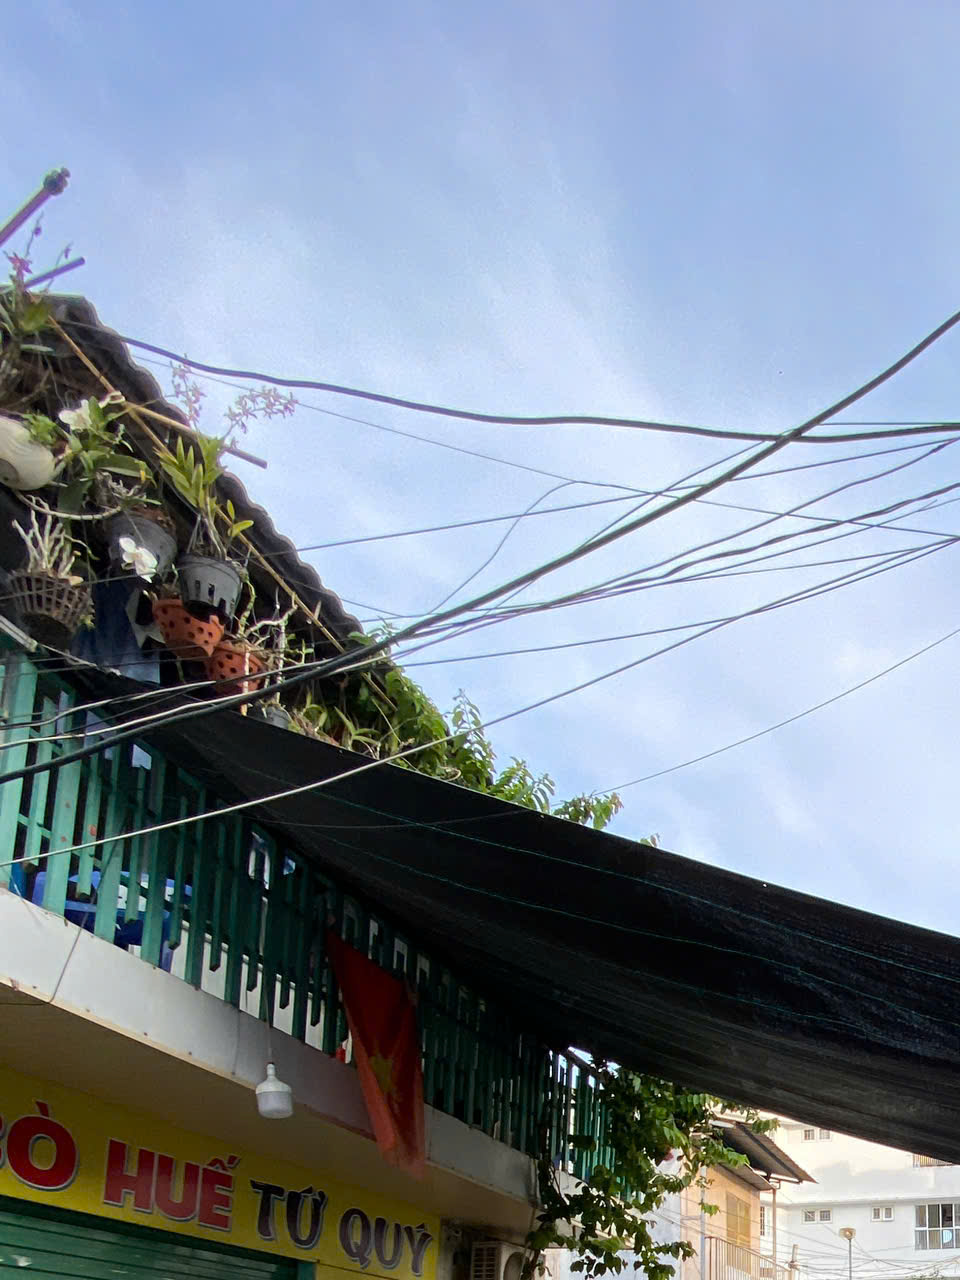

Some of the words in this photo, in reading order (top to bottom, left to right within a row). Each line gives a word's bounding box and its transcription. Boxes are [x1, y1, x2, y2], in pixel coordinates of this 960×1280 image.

[0, 1100, 80, 1191] Ò
[103, 1137, 240, 1232] HUẾ
[249, 1179, 328, 1249] TỨ
[339, 1208, 433, 1277] QUÝ
